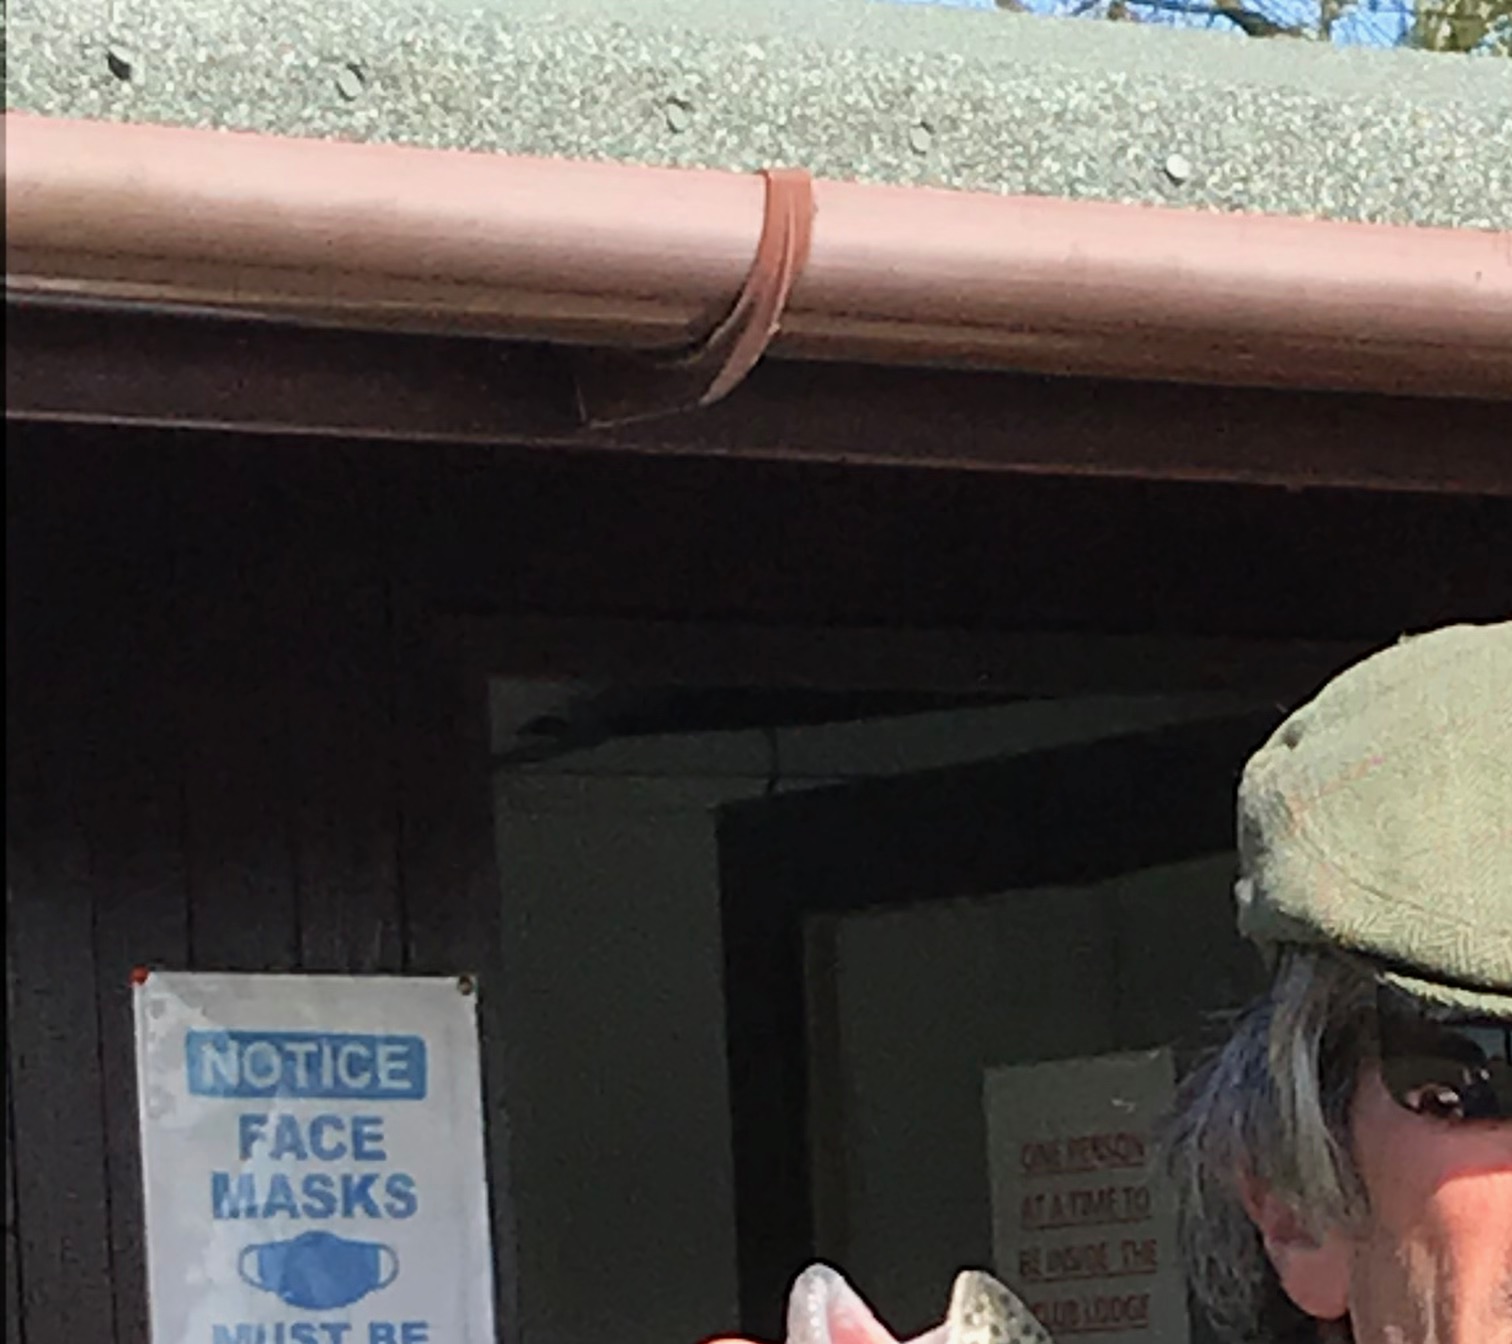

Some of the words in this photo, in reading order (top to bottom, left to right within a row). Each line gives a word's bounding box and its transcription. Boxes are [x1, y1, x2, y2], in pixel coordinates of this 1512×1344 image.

[200, 1039, 412, 1091] NOTICE
[238, 1113, 387, 1162] FACE
[211, 1171, 418, 1221] MASKS
[1120, 1184, 1151, 1215] TO
[1120, 1238, 1158, 1269] THE
